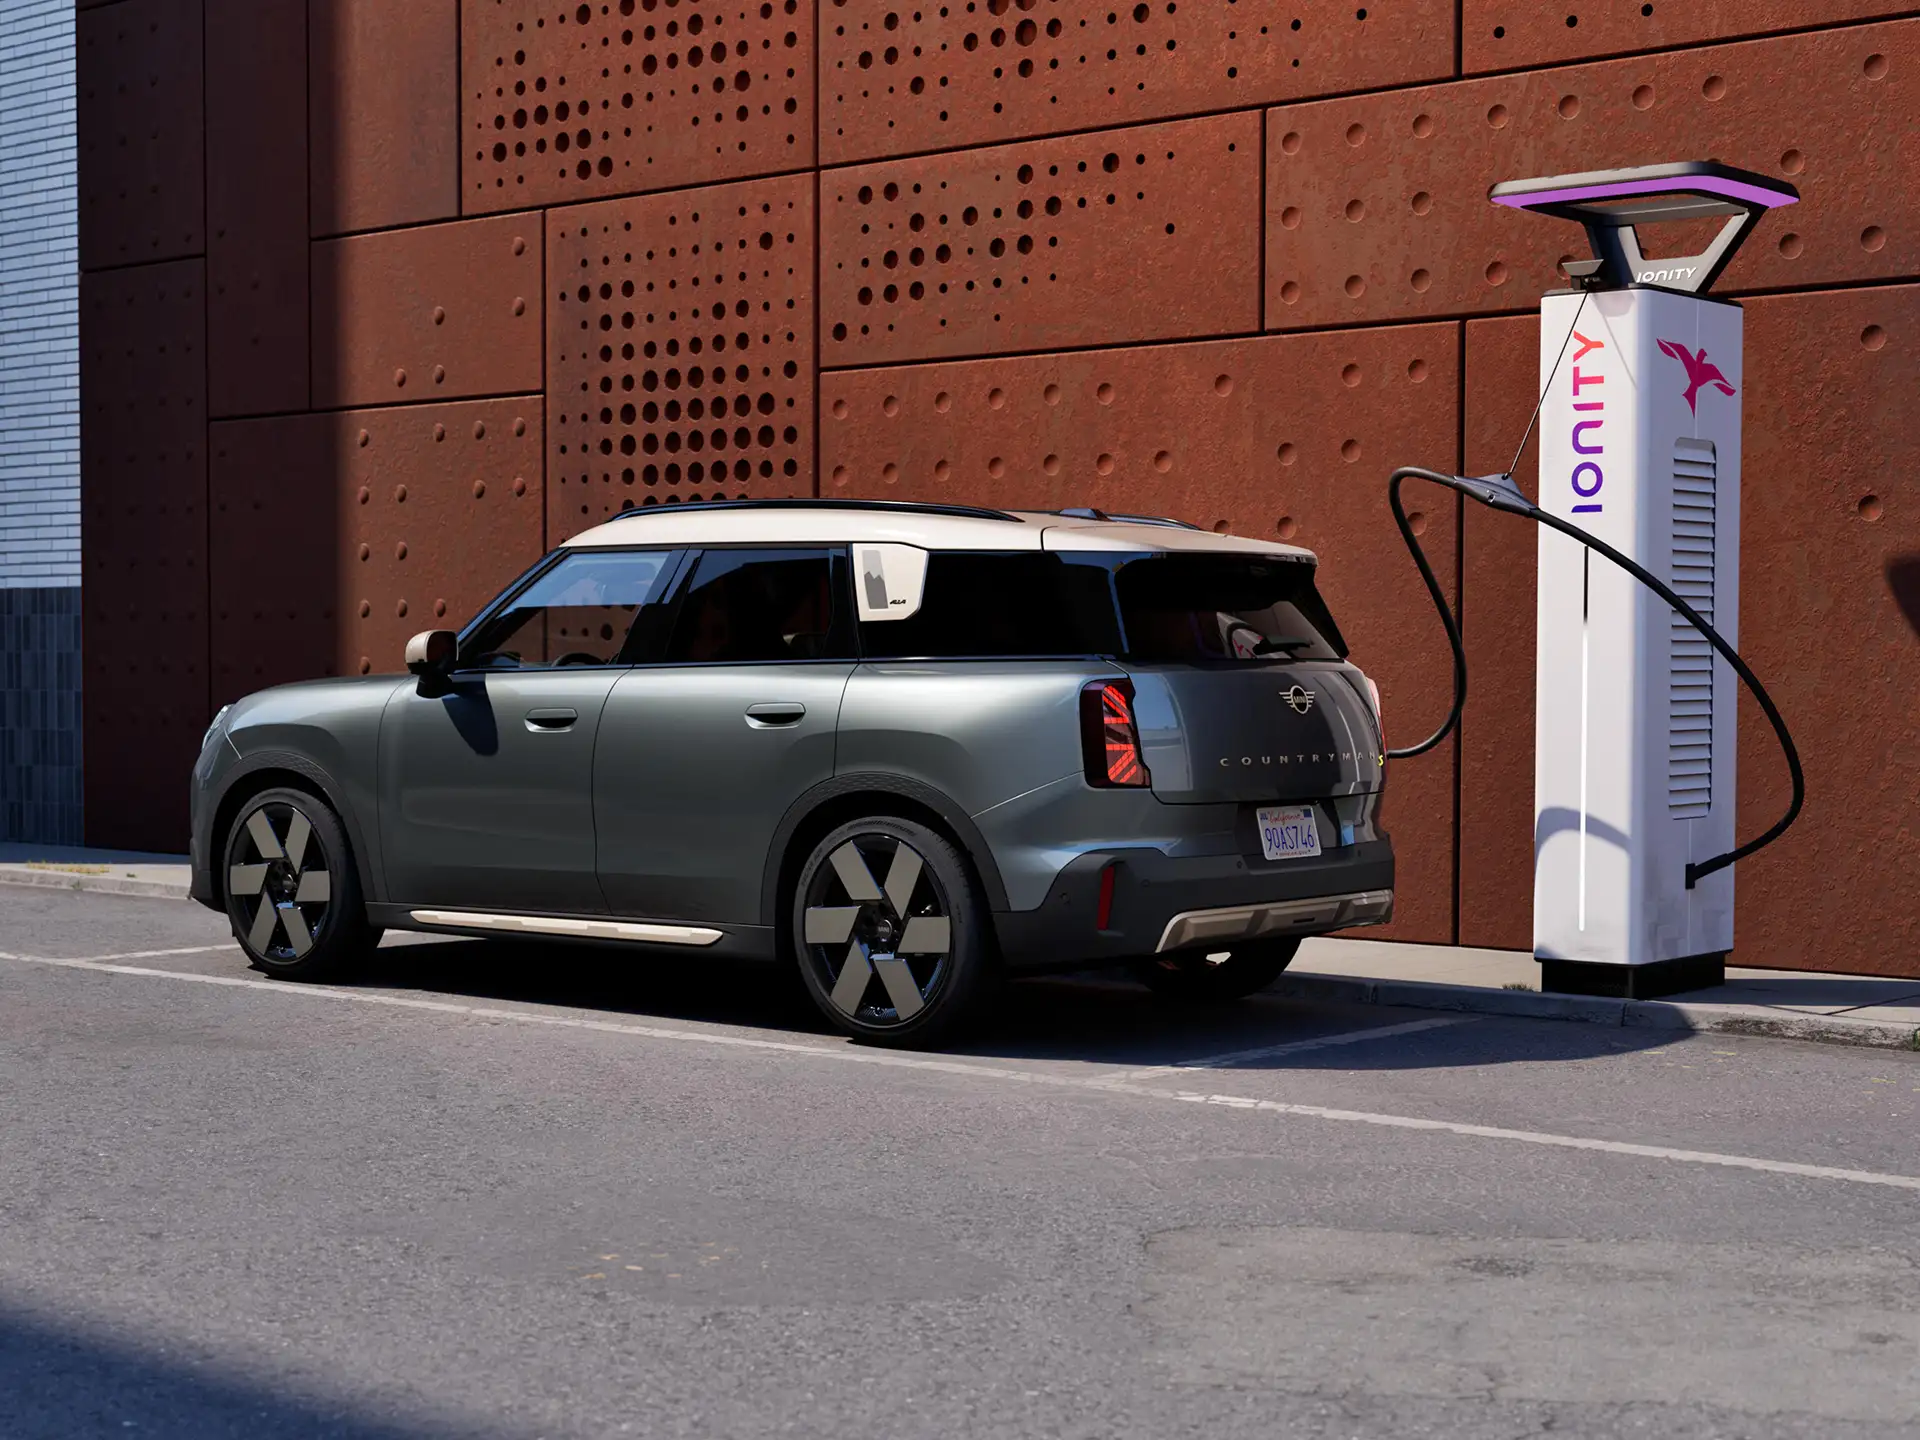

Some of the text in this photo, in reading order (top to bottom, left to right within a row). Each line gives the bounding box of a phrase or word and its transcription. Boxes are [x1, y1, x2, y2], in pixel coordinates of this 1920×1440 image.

[1636, 267, 1697, 283] IONITY
[1571, 330, 1604, 513] IONITY
[1220, 752, 1375, 767] COUNTRYMAN
